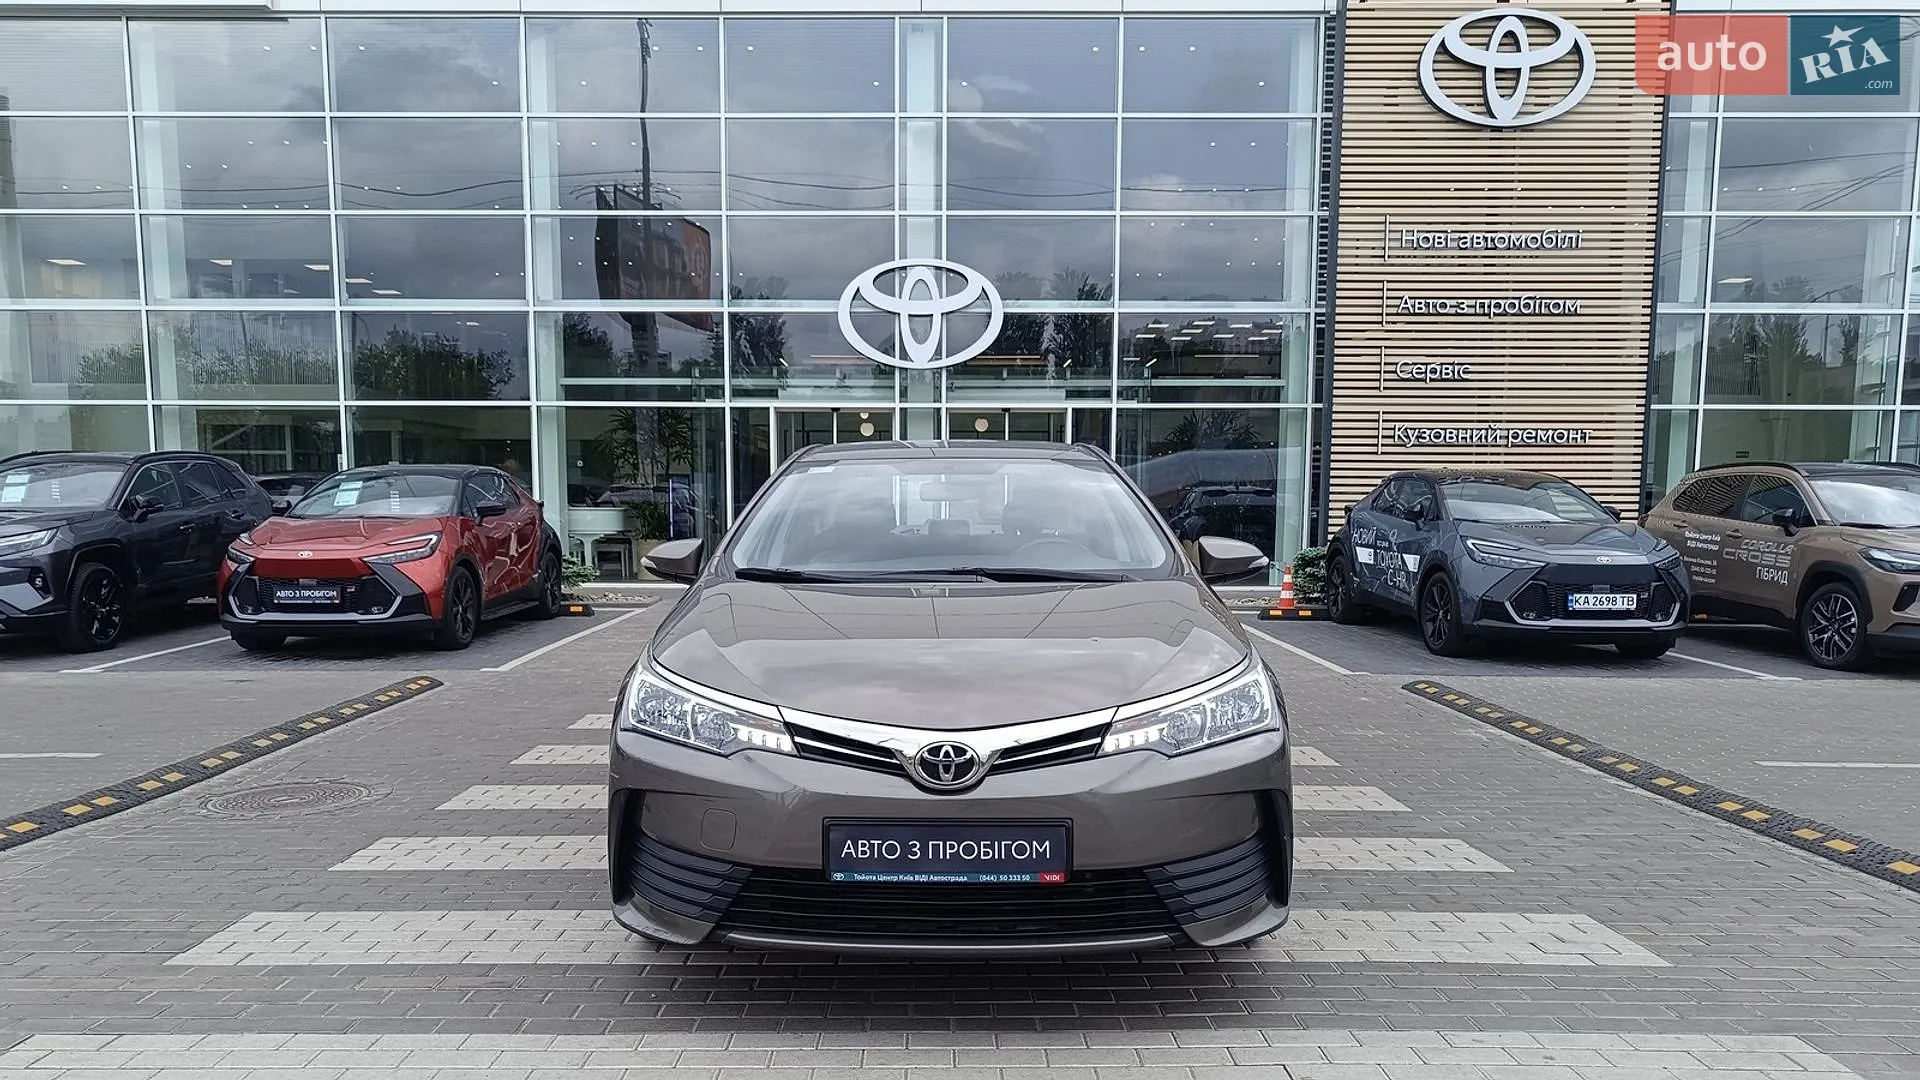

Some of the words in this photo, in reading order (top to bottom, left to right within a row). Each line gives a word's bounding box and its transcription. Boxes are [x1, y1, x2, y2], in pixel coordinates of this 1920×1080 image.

[1401, 228, 1451, 249] Нові
[1458, 228, 1583, 249] автомобілі
[1397, 295, 1450, 314] Авто
[1455, 299, 1468, 314] з
[1475, 294, 1581, 319] пробігом
[1395, 360, 1472, 383] Сервіс
[1393, 423, 1500, 447] Кузовний
[1507, 428, 1594, 448] ремонт
[1740, 539, 1795, 555] COROLLA
[1376, 549, 1403, 570] TOYOTA
[1722, 547, 1792, 568] CROSS
[1387, 568, 1410, 592] C-HR
[1755, 566, 1789, 586] ГІБРИД
[276, 590, 295, 598] АВТО
[295, 590, 300, 598] З
[301, 590, 337, 598] ПРОБІГОМ
[1574, 595, 1590, 607] KA
[1592, 595, 1618, 607] 2698
[1620, 595, 1635, 607] TB
[841, 840, 900, 860] АВТО
[907, 840, 921, 860] З
[928, 840, 1050, 860] ПРОБІГОМ
[853, 873, 876, 881] Тойота
[877, 874, 899, 882] Центр
[914, 874, 928, 882] ВІДІ
[929, 874, 968, 882] Автострада
[979, 874, 998, 882] (044)
